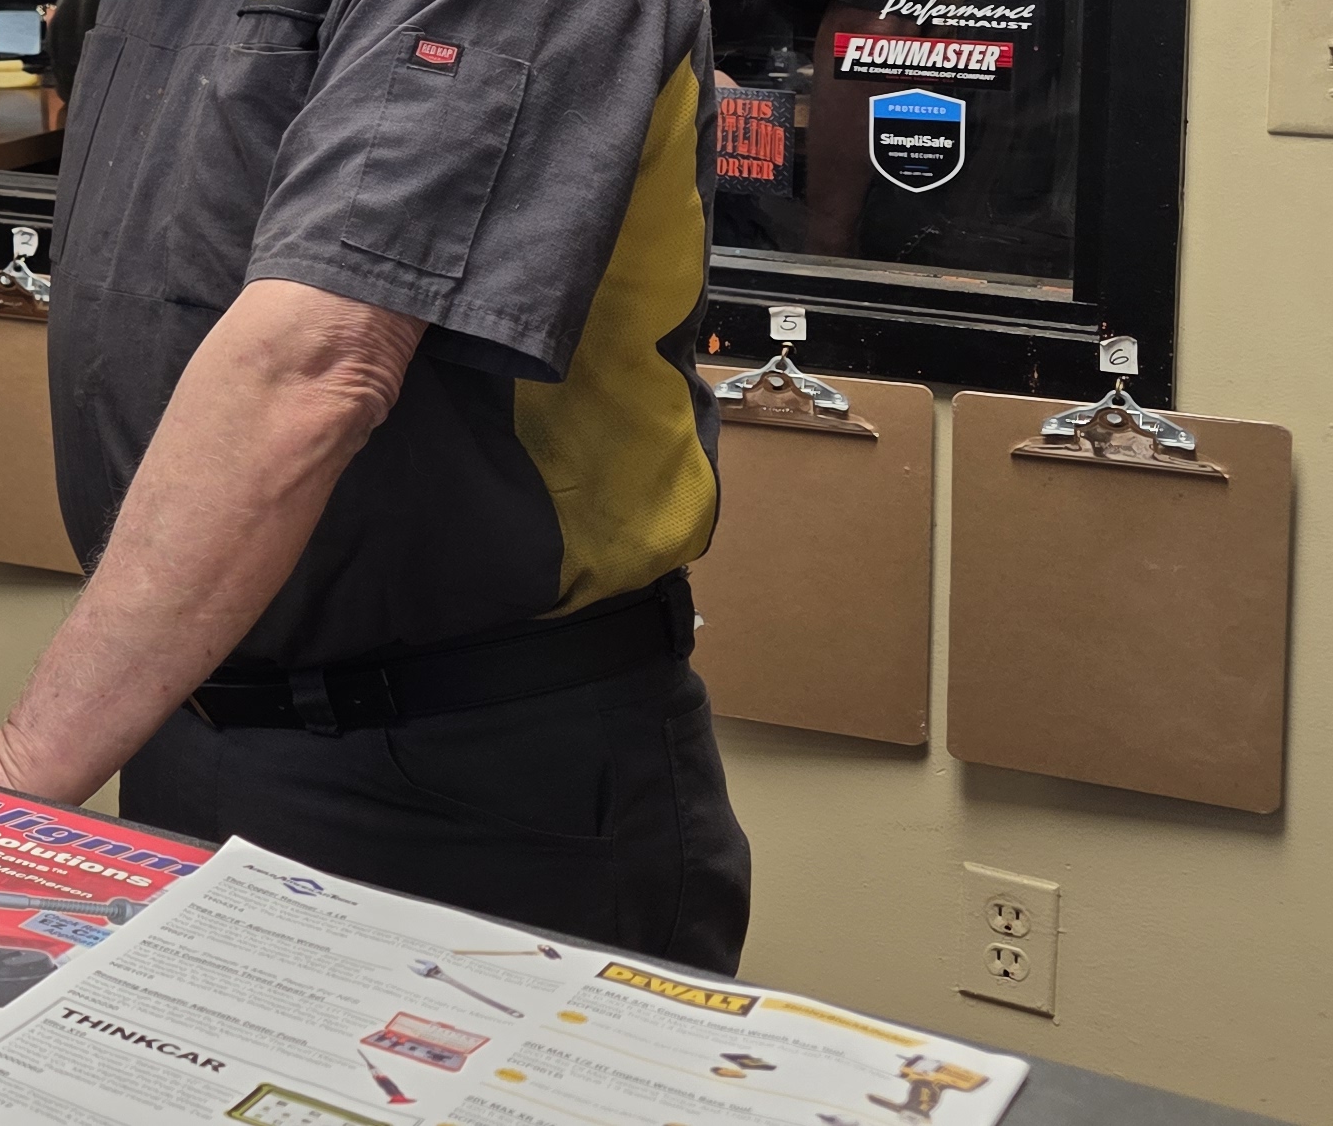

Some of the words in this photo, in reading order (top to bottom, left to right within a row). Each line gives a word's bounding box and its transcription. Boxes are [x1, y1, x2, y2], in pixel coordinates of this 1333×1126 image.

[931, 18, 1032, 30] EXHAUST
[422, 43, 437, 55] RED
[437, 47, 453, 58] KAP
[841, 37, 1001, 71] FLOWMASTER
[853, 65, 868, 73] THE
[869, 66, 902, 75] EXHAUST
[904, 68, 956, 79] TECHNOLOGY
[957, 73, 995, 81] COMPANY
[718, 98, 773, 119] OUIS
[888, 104, 947, 115] PROTECTED
[717, 115, 785, 166] TLING
[880, 132, 952, 149] SimpliSafe
[888, 151, 908, 159] HOME
[910, 152, 944, 160] SECURITY
[20, 231, 33, 247] 2
[779, 315, 798, 333] 5
[1108, 348, 1130, 367] 6
[602, 966, 751, 1012] DEWALT
[62, 1007, 226, 1073] THINKCAR
